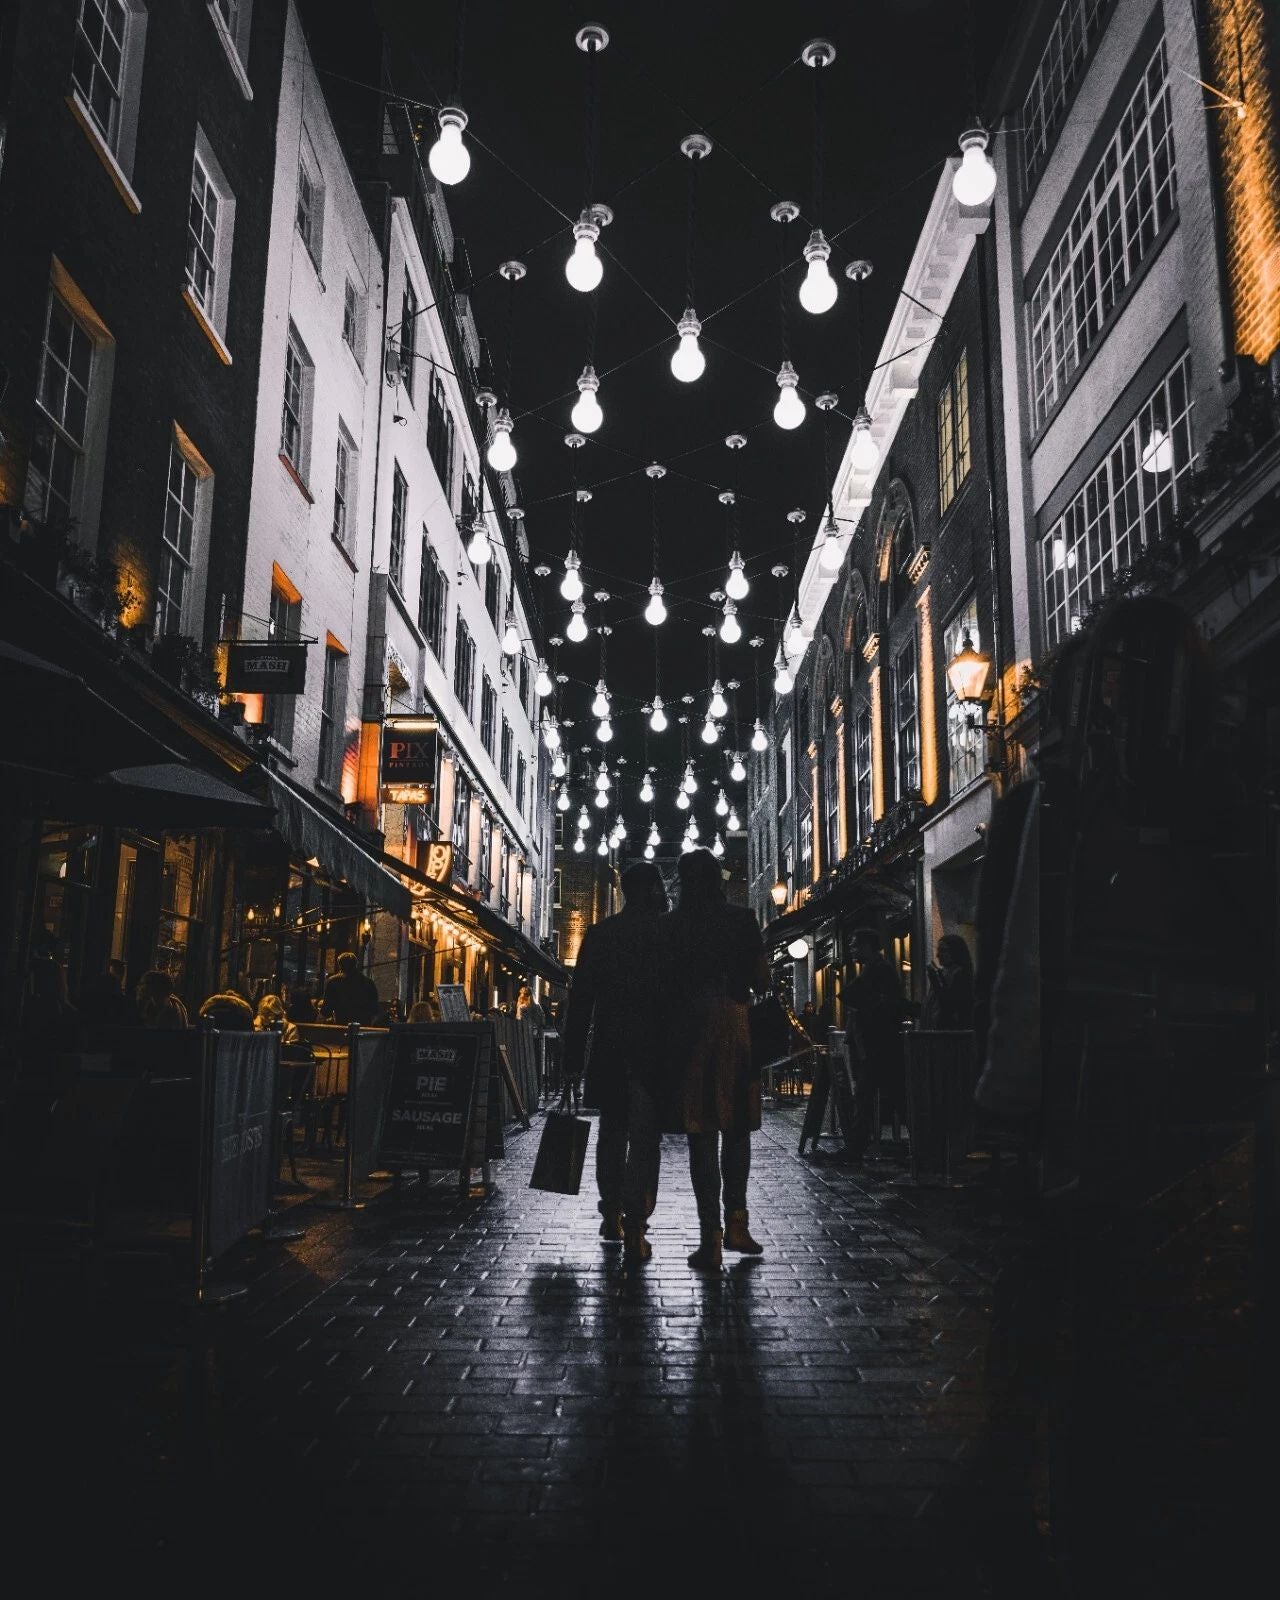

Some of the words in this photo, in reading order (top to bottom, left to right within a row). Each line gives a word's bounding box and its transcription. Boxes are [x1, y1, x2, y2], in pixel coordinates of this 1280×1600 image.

[246, 661, 292, 671] MASH
[389, 742, 429, 759] PIX
[417, 1076, 447, 1091] PIE
[392, 1109, 464, 1125] SAUSAGE
